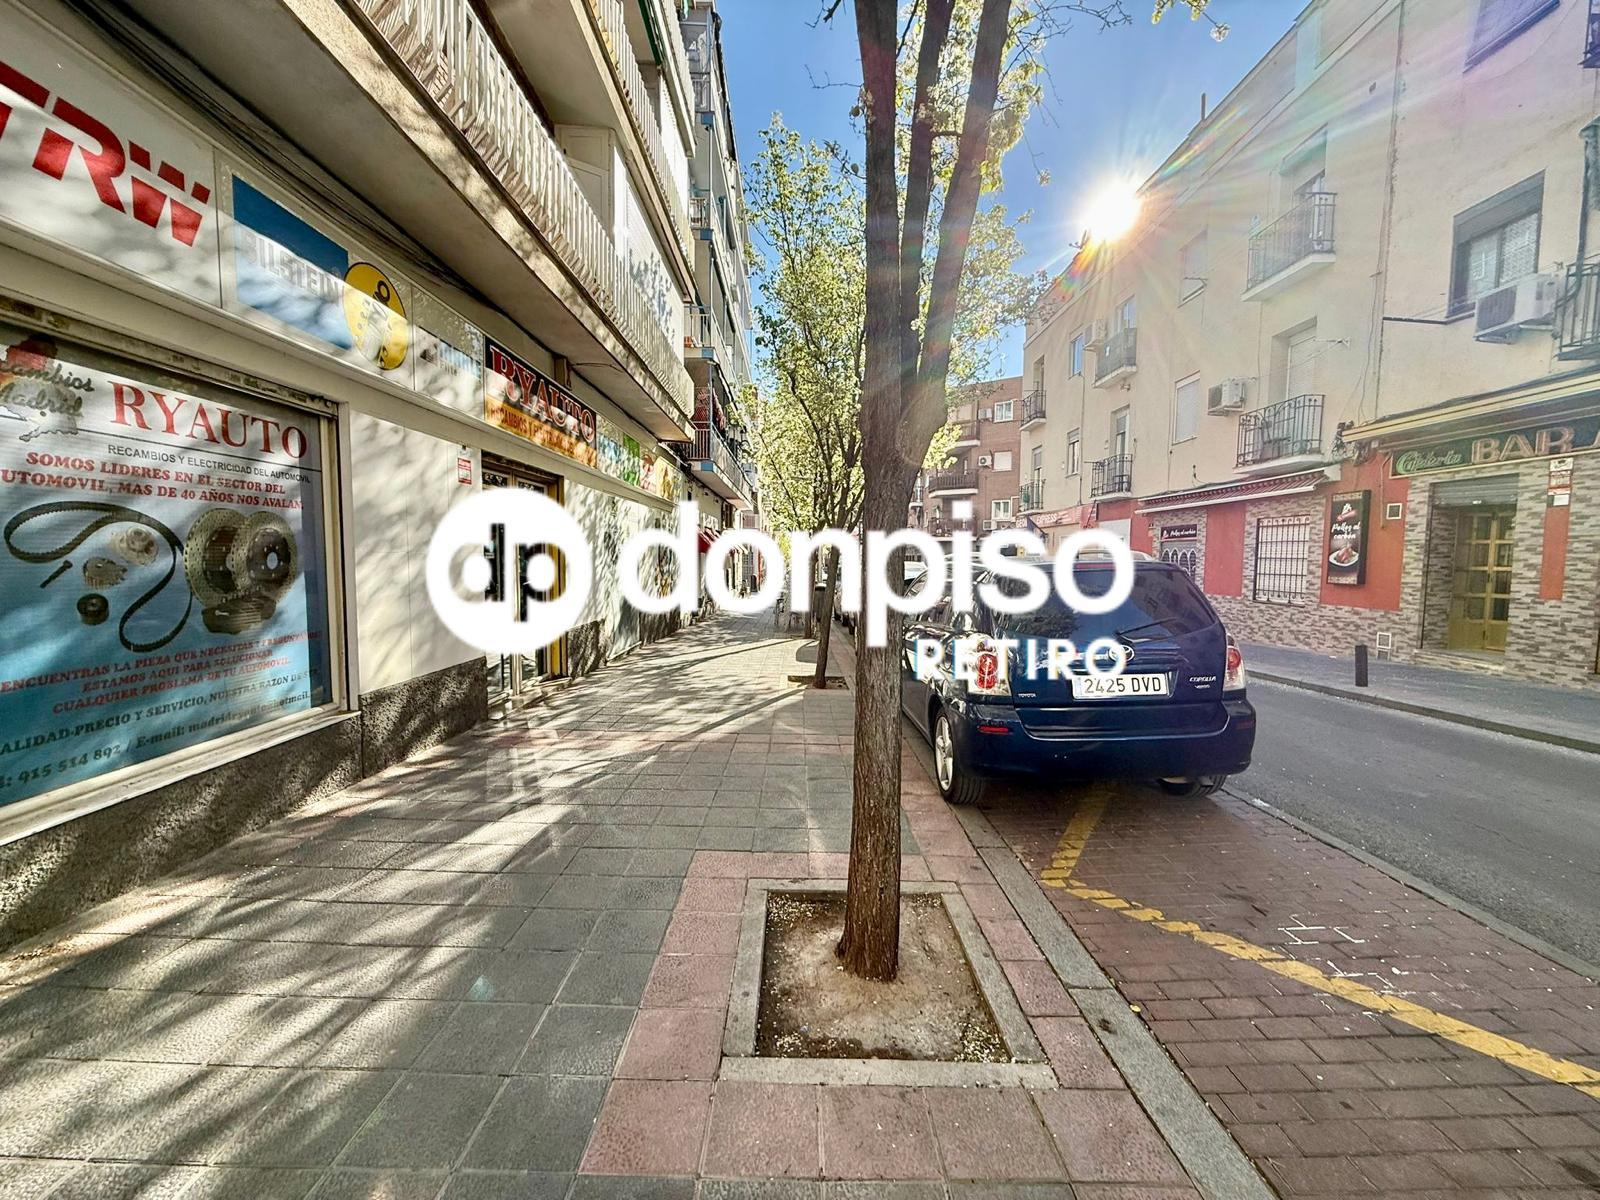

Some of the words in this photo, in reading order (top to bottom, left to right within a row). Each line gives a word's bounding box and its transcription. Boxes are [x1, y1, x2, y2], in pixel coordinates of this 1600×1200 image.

[489, 345, 595, 443] RYAUTO
[107, 381, 308, 459] RYAUTO
[107, 444, 176, 463] RECAMBIOS
[178, 455, 186, 464] Y
[187, 457, 252, 475] ELECTRICIDAD
[253, 467, 269, 478] DEL
[1471, 426, 1575, 464] BAR
[26, 452, 95, 472] SOMOS
[100, 462, 171, 481] LIDERES
[174, 471, 194, 483] EN
[197, 475, 214, 487] EL
[217, 478, 262, 493] SECTOR
[264, 483, 286, 495] DEL
[117, 482, 153, 496] MAS
[157, 486, 178, 498] DE
[181, 489, 196, 501] 40
[200, 488, 235, 504] AÑOS
[237, 495, 260, 506] NOS
[1, 664, 111, 692] ENCUENTRAS
[115, 662, 131, 673] LA
[136, 656, 170, 668] PIEZA
[174, 650, 198, 663] QUE
[83, 671, 146, 692] ESTAMOS
[149, 667, 180, 679] AQUI
[183, 660, 211, 673] PARA
[215, 649, 273, 667] SOLUCIONAR
[1084, 677, 1126, 694] 2425
[1131, 676, 1162, 692] DVD
[53, 688, 138, 714] CUALQUIER
[207, 670, 221, 680] DE
[135, 711, 144, 721] Y
[259, 675, 289, 689] RAZON
[18, 764, 52, 784] 915
[58, 753, 89, 773] 514
[93, 745, 121, 760] 892
